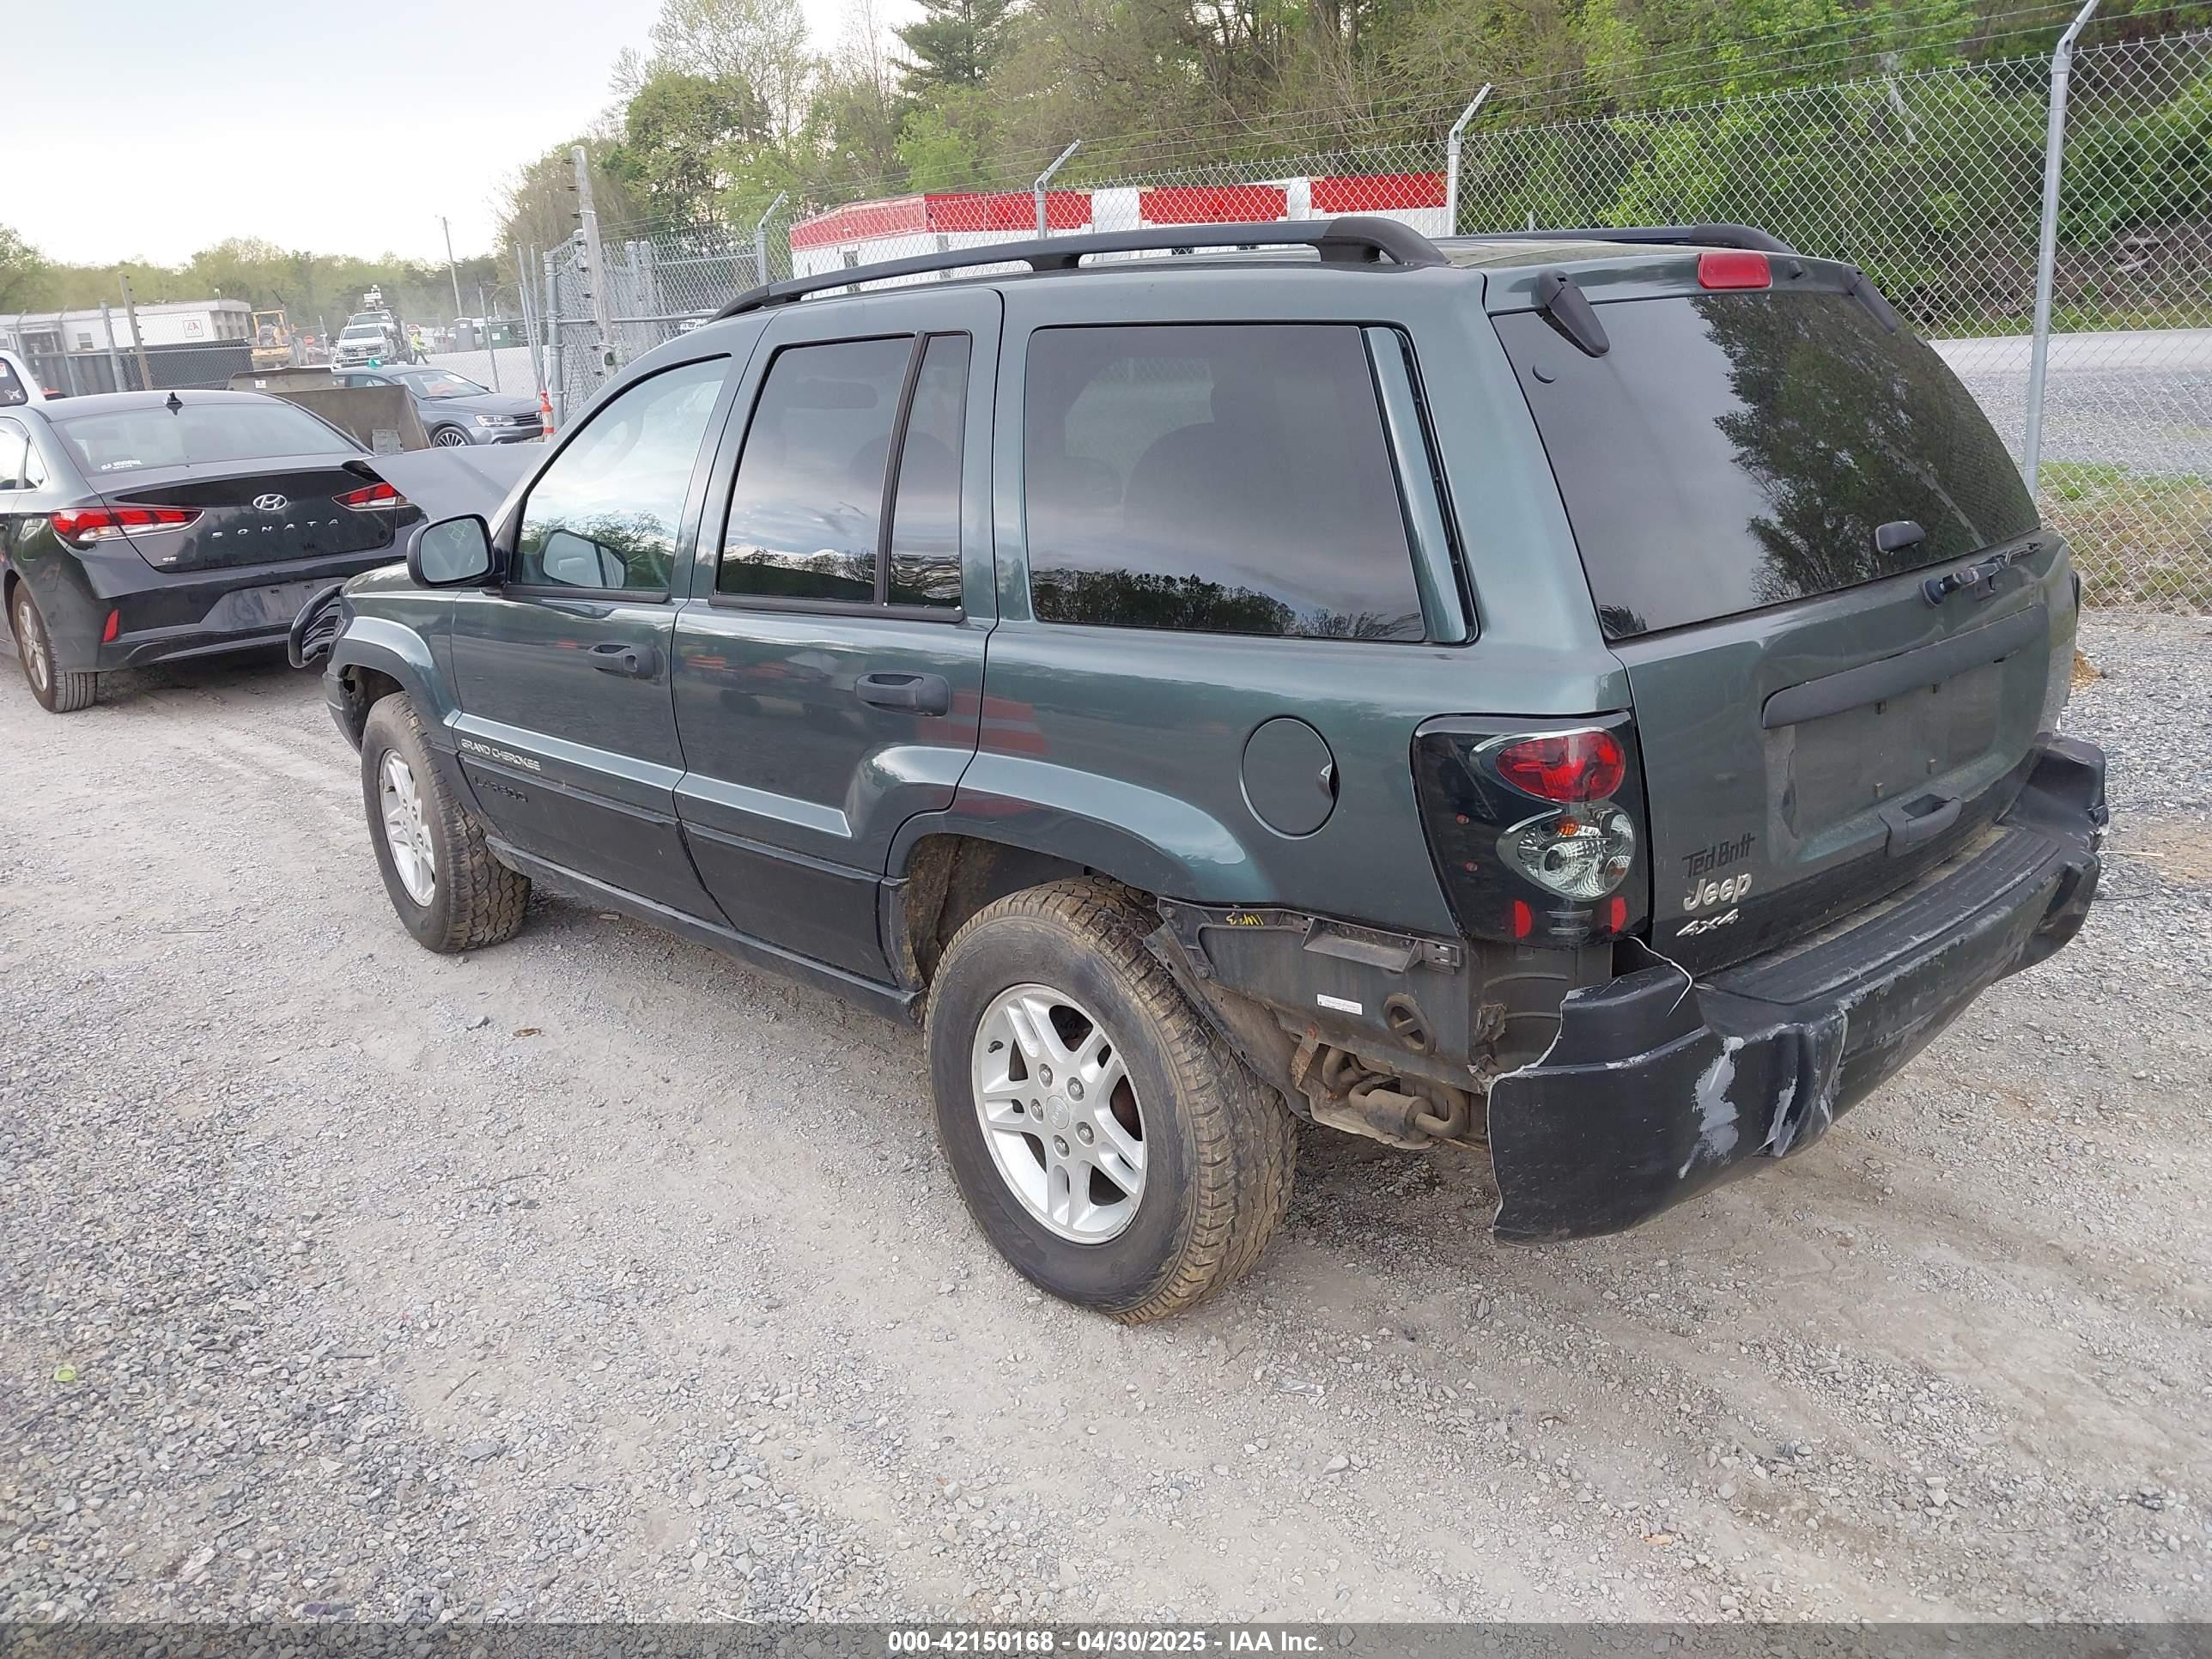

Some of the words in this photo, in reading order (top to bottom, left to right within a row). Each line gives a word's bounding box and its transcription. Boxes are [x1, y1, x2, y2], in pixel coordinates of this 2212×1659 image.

[210, 519, 339, 538] SONATA
[460, 738, 490, 756] GRAND
[491, 748, 541, 772] CHEROKEE
[1681, 846, 1716, 878] Ted
[1718, 832, 1756, 867] Britt
[1682, 872, 1753, 911] Jeep
